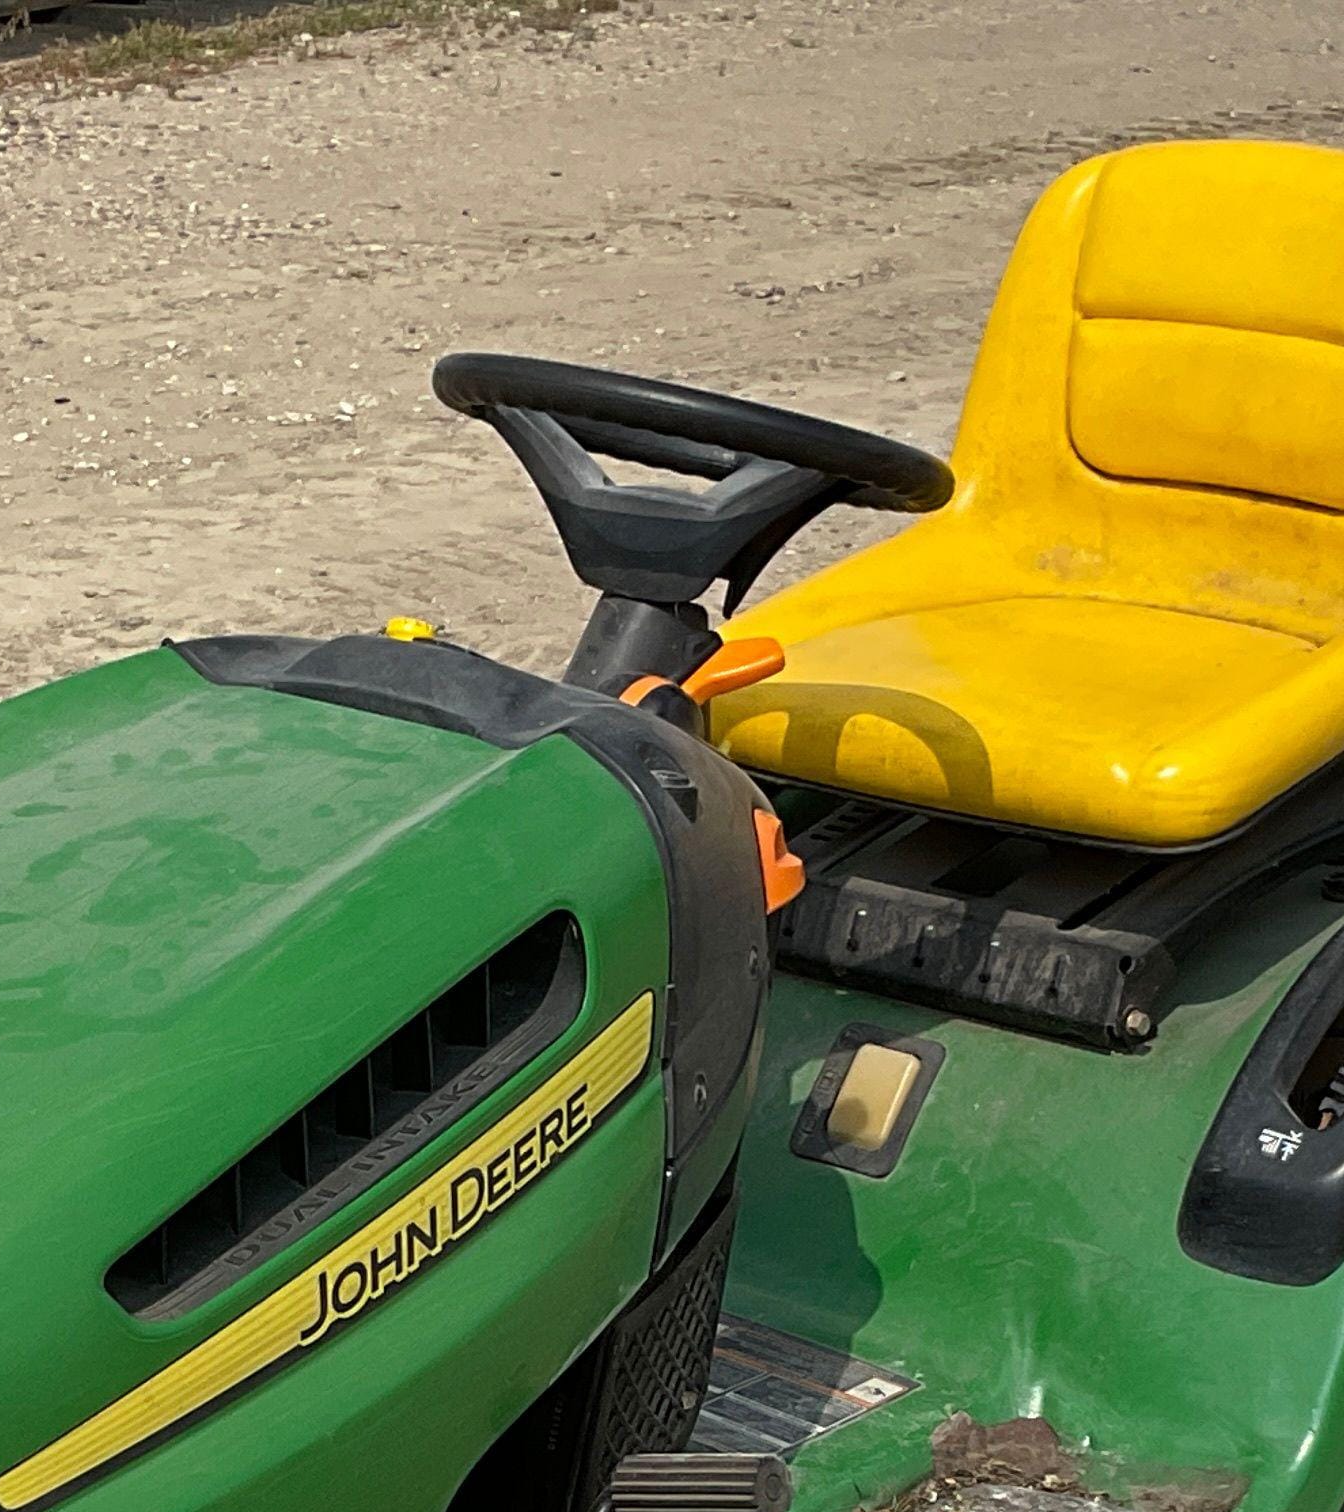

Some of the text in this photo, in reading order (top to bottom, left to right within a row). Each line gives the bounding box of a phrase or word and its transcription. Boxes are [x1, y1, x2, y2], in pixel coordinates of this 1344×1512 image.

[227, 1064, 495, 1267] DUAL INTAKE
[299, 1082, 589, 1342] JOHN DEERE
